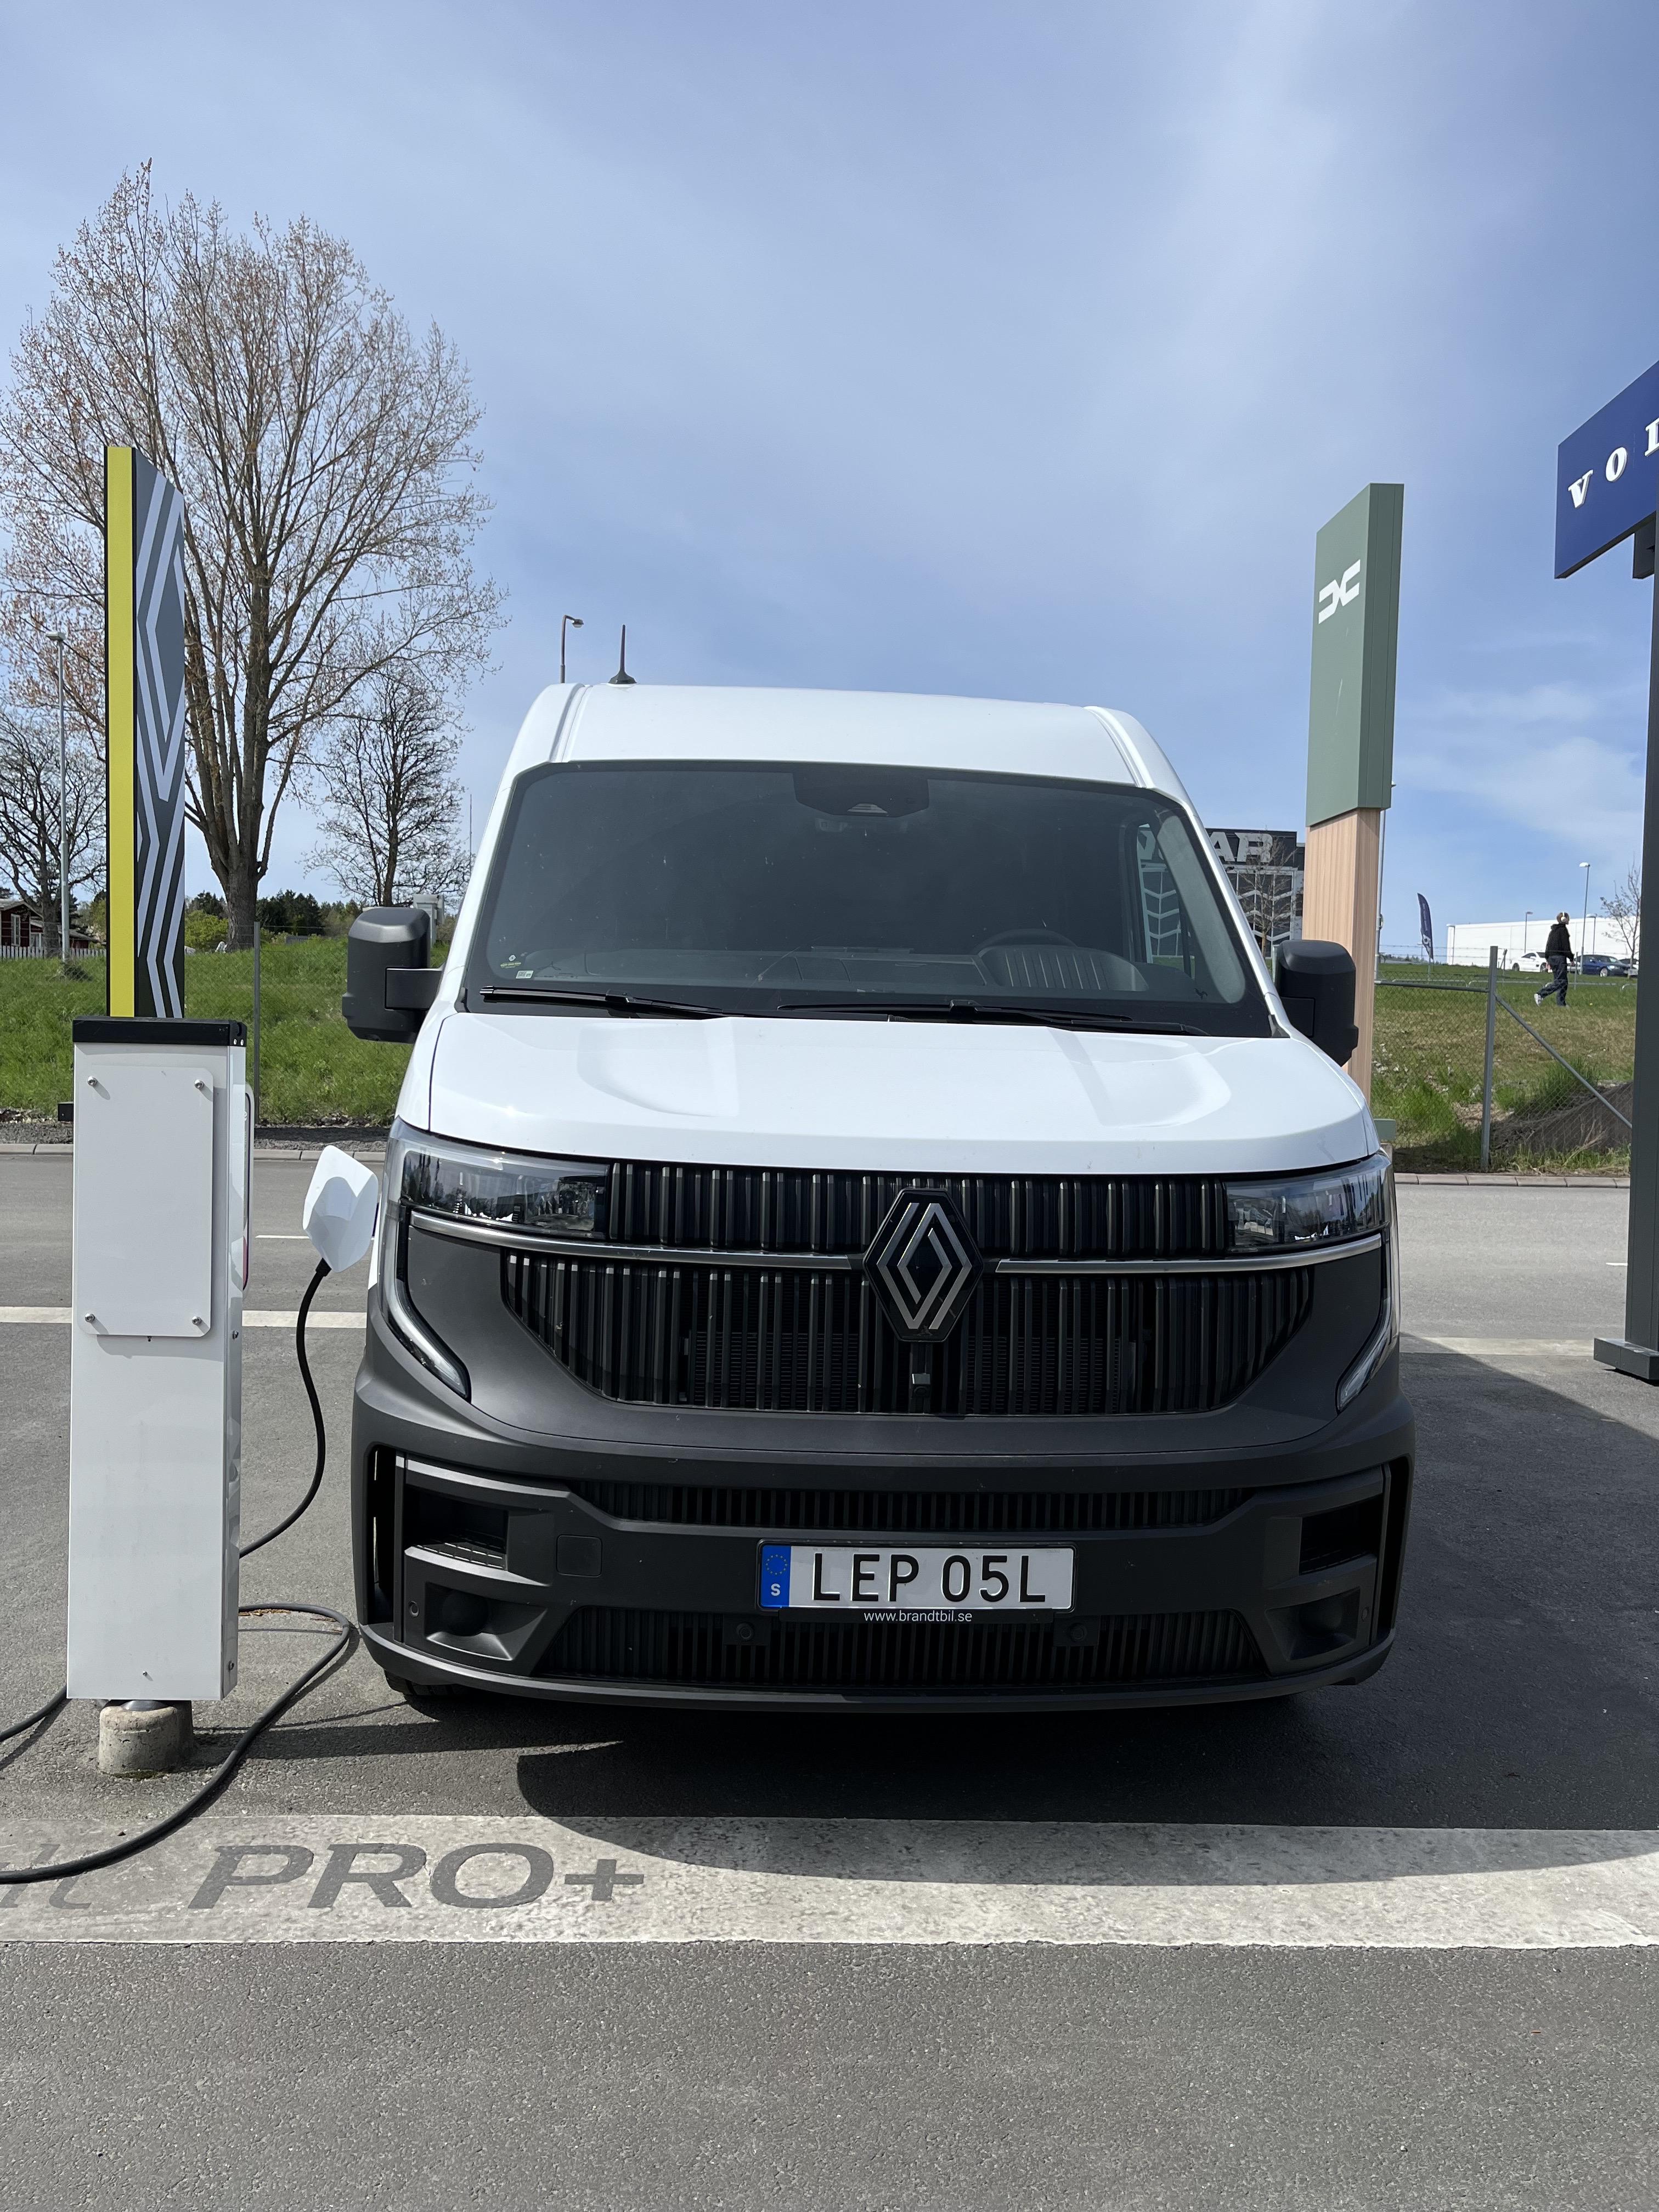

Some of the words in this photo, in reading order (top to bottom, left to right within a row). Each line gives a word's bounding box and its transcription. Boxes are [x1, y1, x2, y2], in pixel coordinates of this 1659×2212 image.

[770, 1583, 781, 1596] S
[813, 1553, 919, 1602] LEP
[941, 1554, 1046, 1602] 05L
[864, 1609, 973, 1623] www.brandtbil.se
[188, 1842, 644, 1909] PRO+
